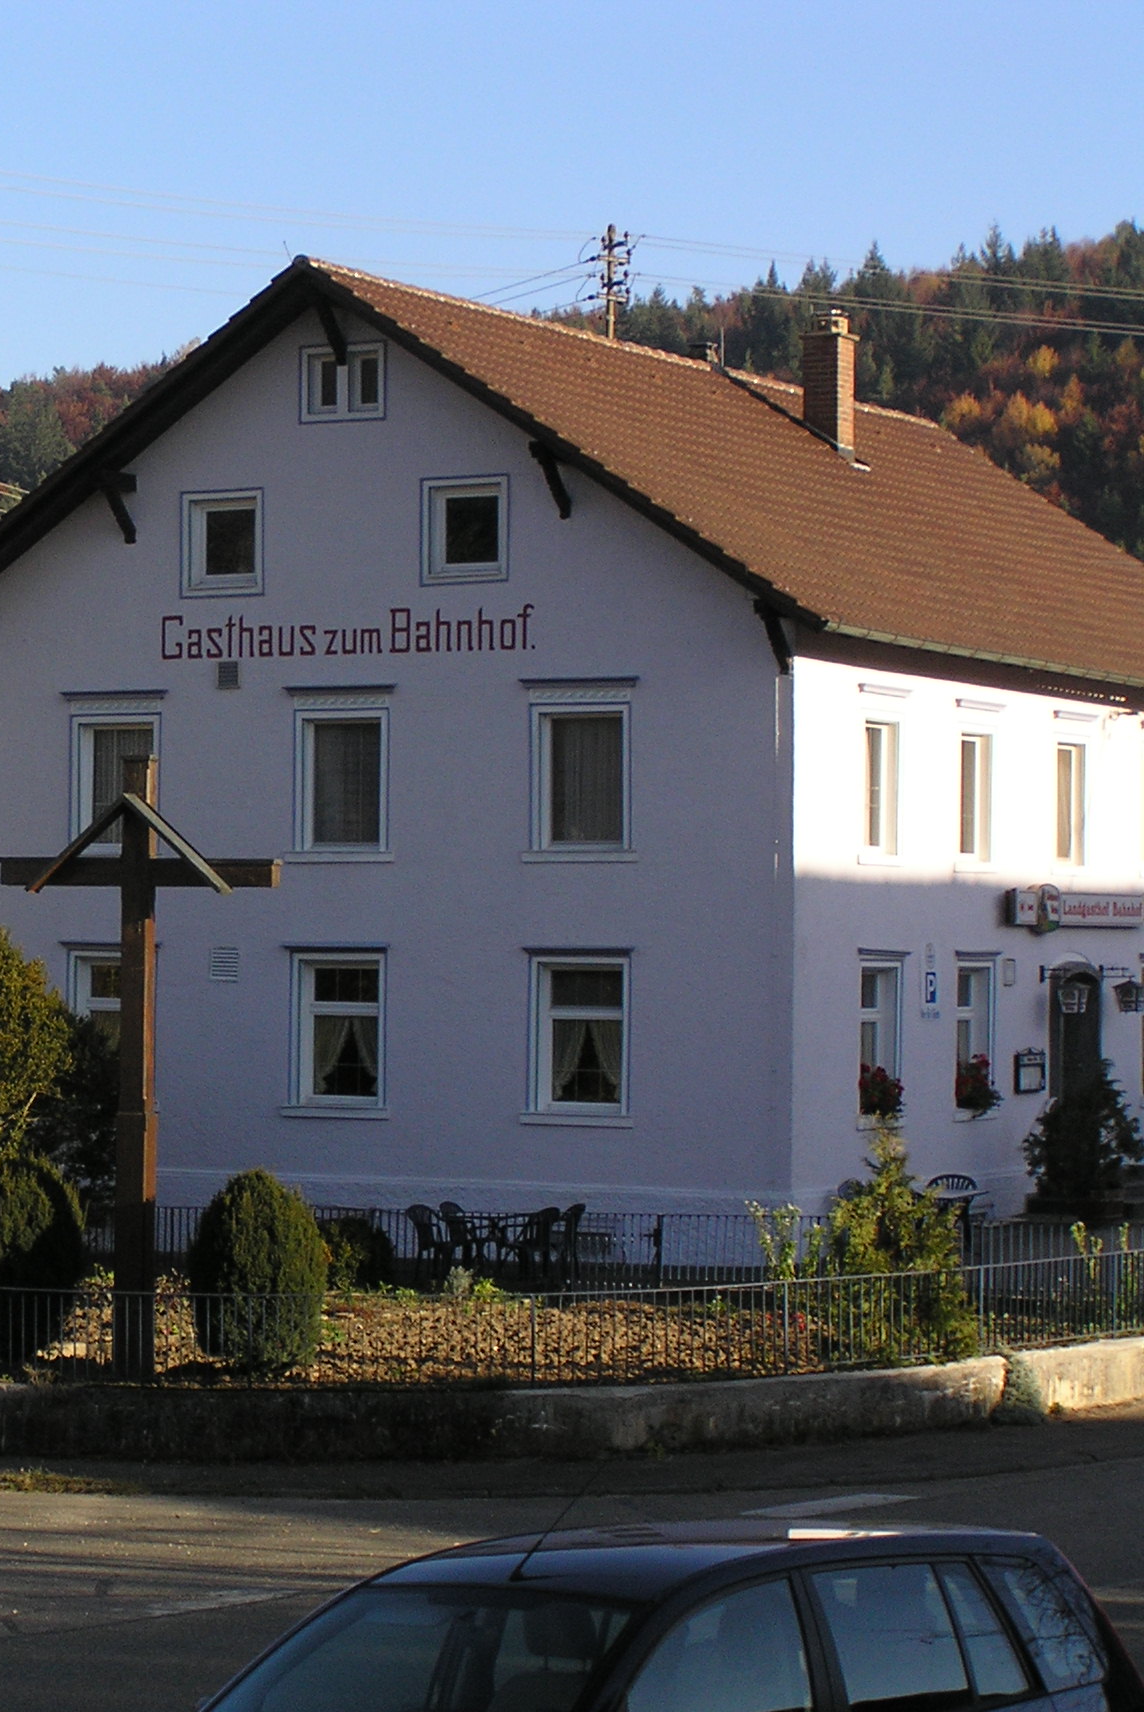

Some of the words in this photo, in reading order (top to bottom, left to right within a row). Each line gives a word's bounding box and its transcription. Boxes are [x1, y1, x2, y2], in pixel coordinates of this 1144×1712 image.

[161, 614, 316, 660] Gasthaus
[323, 628, 383, 655] zum
[389, 603, 536, 654] Bahnhof.
[1063, 900, 1109, 919] Landgasthof
[1112, 901, 1143, 917] Bahnhof
[926, 974, 936, 1002] P
